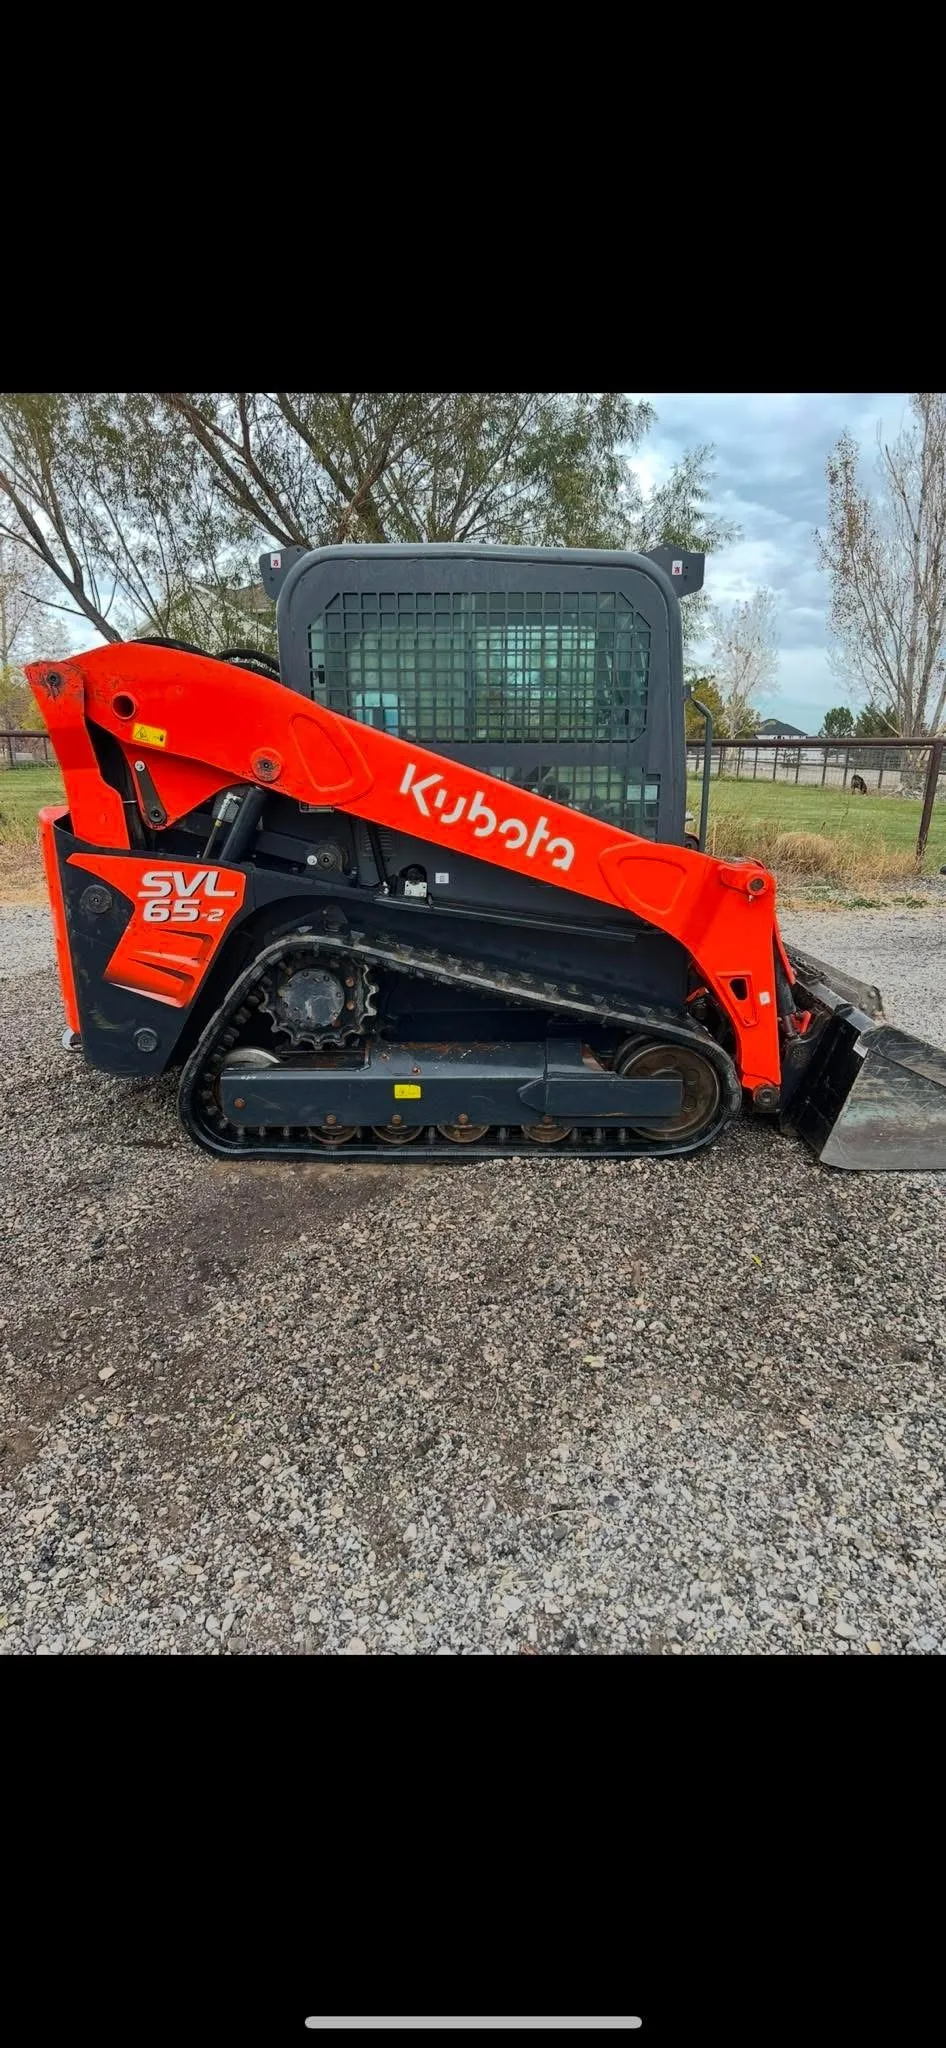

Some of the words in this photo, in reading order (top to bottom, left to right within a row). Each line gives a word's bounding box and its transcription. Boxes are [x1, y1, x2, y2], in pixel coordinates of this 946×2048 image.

[400, 763, 575, 871] Kubota
[137, 871, 236, 897] SVL
[143, 899, 225, 922] 65-2
